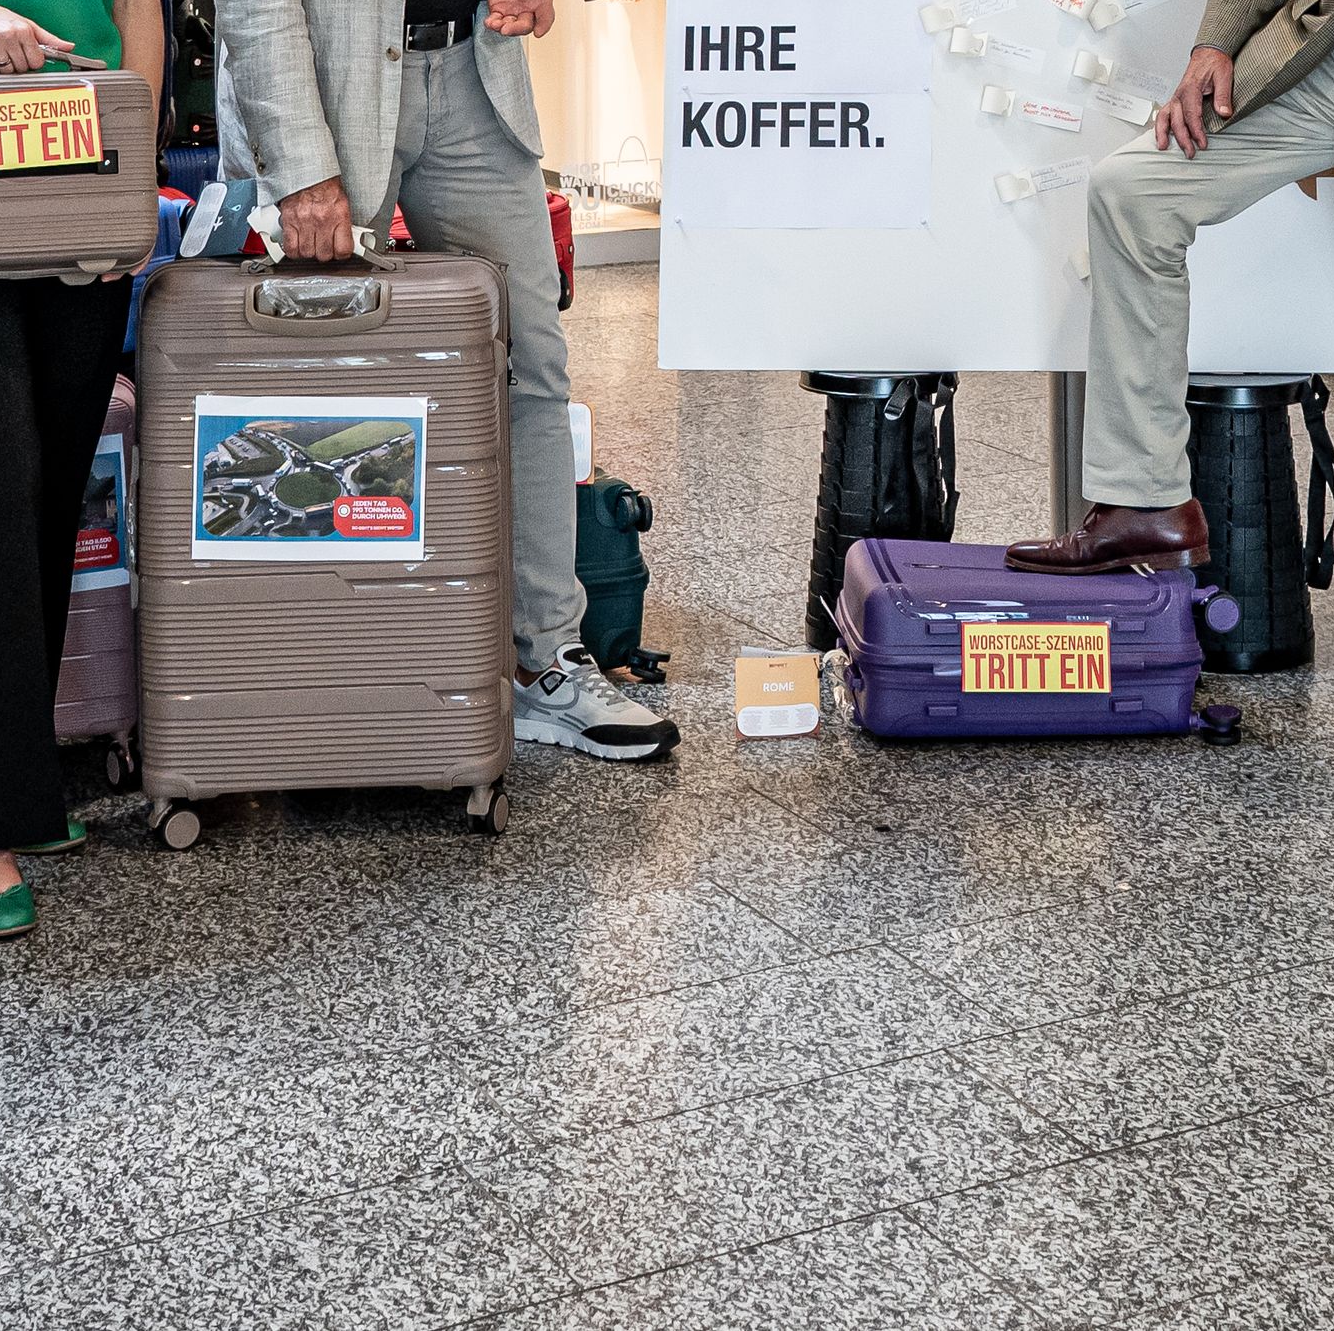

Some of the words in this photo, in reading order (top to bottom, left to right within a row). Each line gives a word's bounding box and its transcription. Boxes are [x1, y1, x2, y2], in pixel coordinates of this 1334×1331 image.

[684, 25, 797, 72] IHRE
[41, 118, 96, 162] EIN
[681, 101, 885, 148] KOFFER.
[607, 182, 654, 198] CLICK
[969, 634, 1104, 652] WORSTCASE-SZENARIO
[762, 681, 795, 693] ROME
[969, 654, 1050, 690] TRITT
[1060, 654, 1105, 690] EIN
